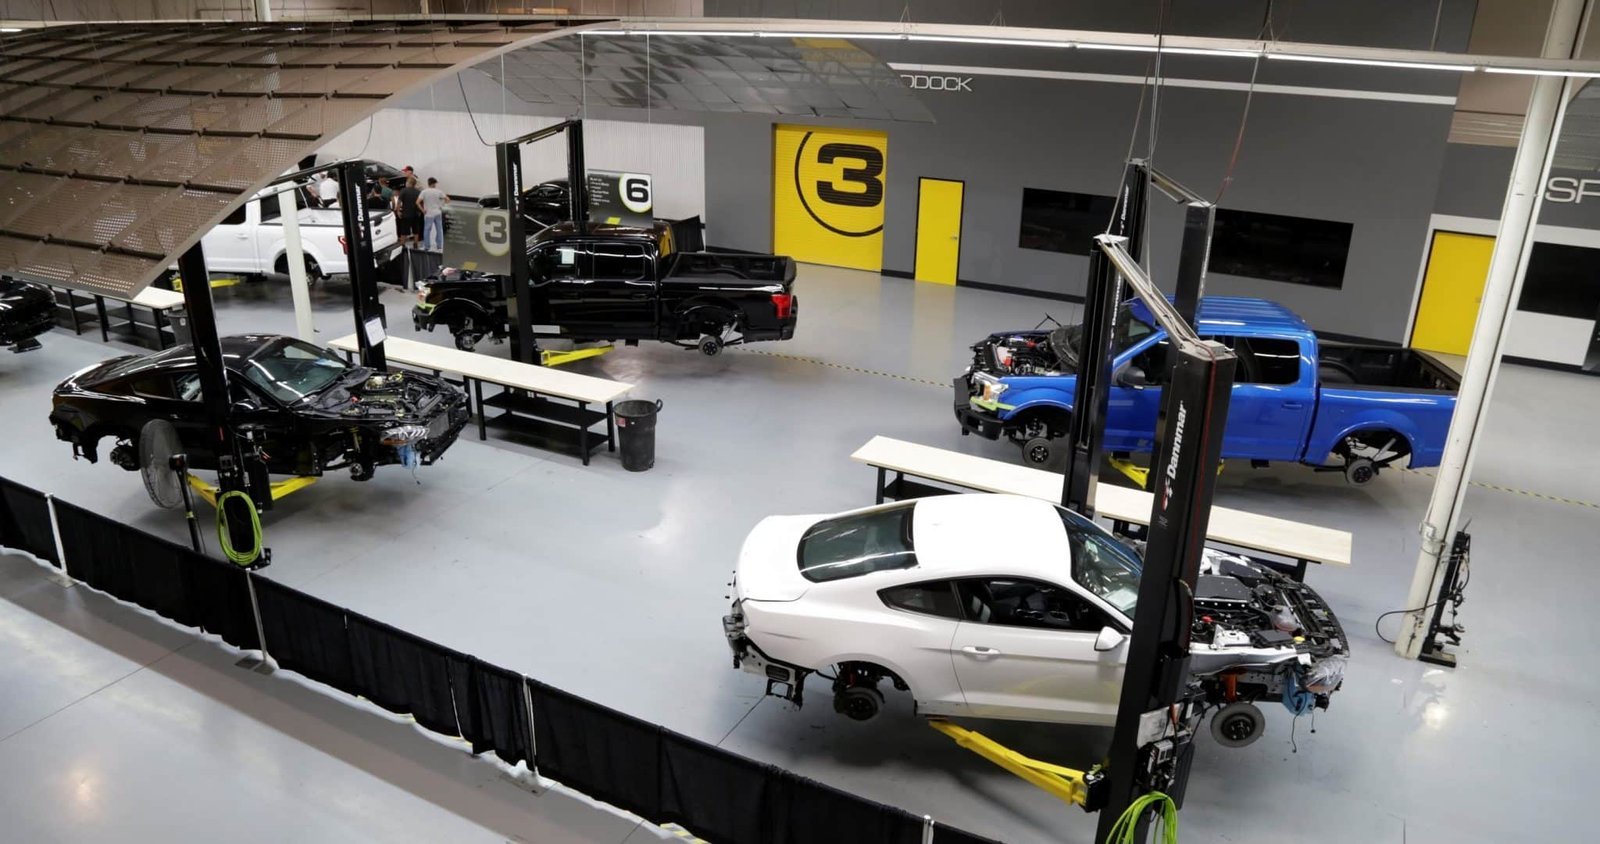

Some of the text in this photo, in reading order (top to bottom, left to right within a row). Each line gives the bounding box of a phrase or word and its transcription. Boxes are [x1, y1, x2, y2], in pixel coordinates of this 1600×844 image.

[899, 74, 974, 92] DDOCK
[626, 178, 649, 203] 6
[816, 142, 884, 208] 3
[484, 214, 507, 245] 3
[1166, 400, 1187, 480] Dannmar
